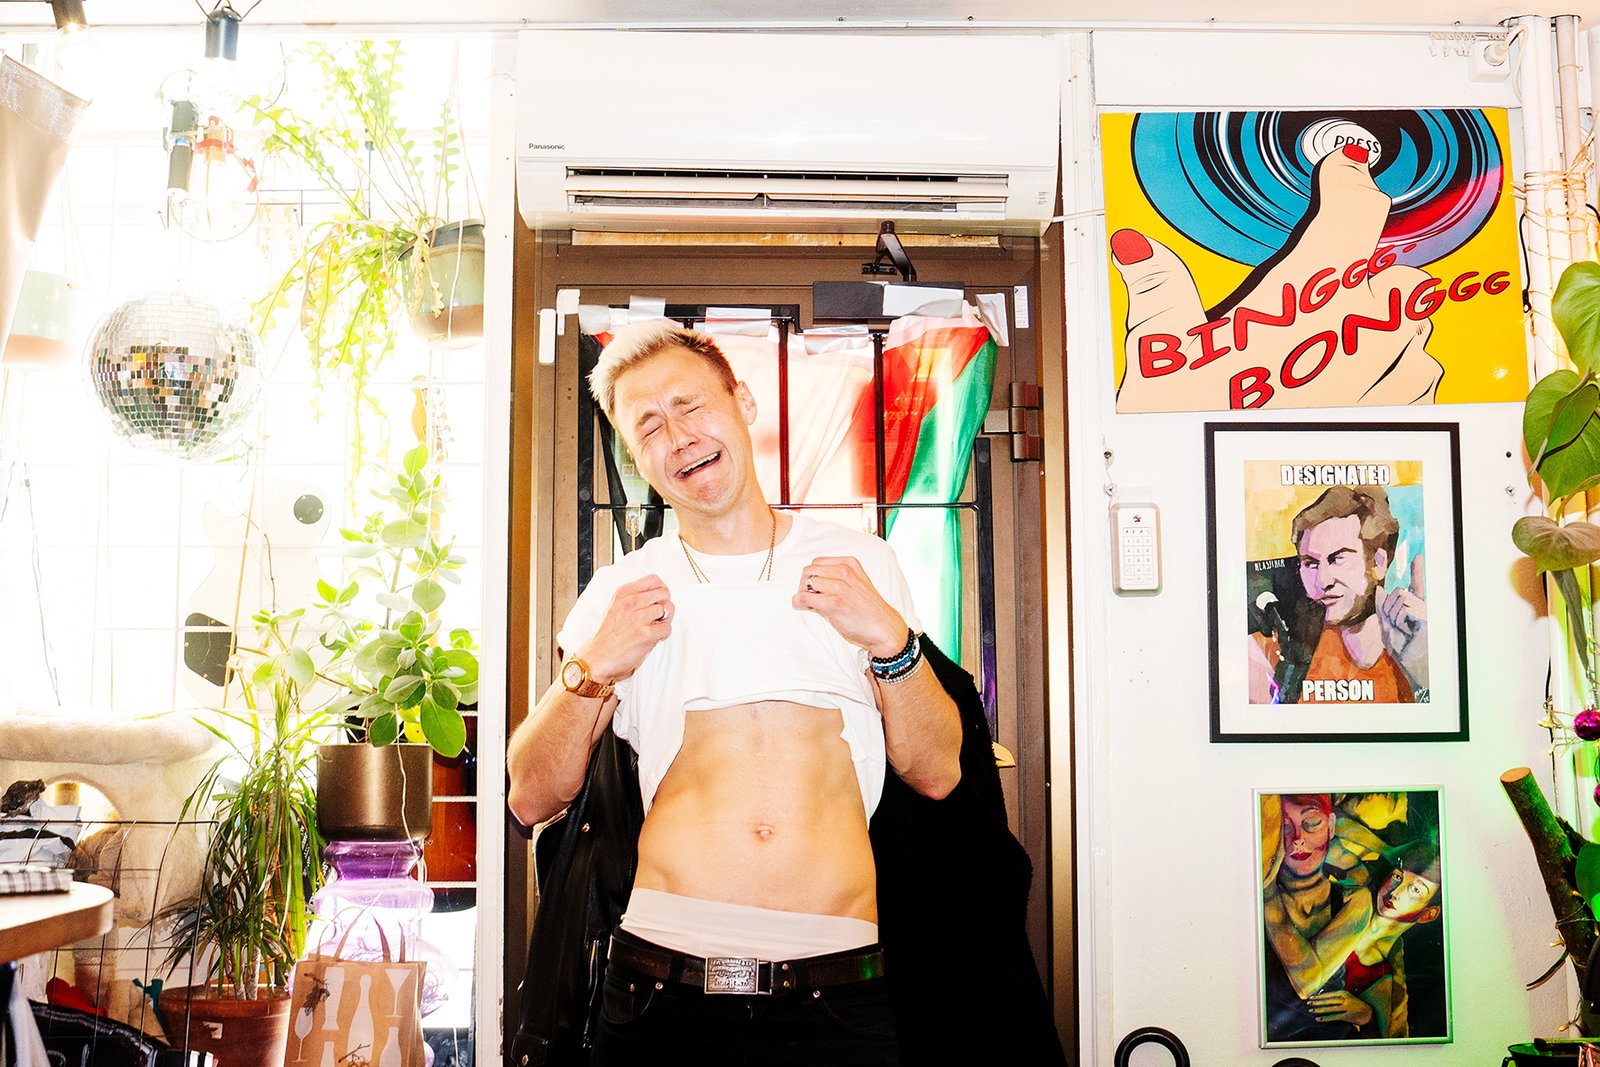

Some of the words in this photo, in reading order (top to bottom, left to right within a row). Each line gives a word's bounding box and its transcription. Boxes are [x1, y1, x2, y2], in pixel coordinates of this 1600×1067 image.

[528, 142, 566, 150] Panasonic
[1229, 271, 1511, 410] BONGGG
[1280, 464, 1391, 486] DESIGNATED
[1302, 679, 1375, 702] PERSON
